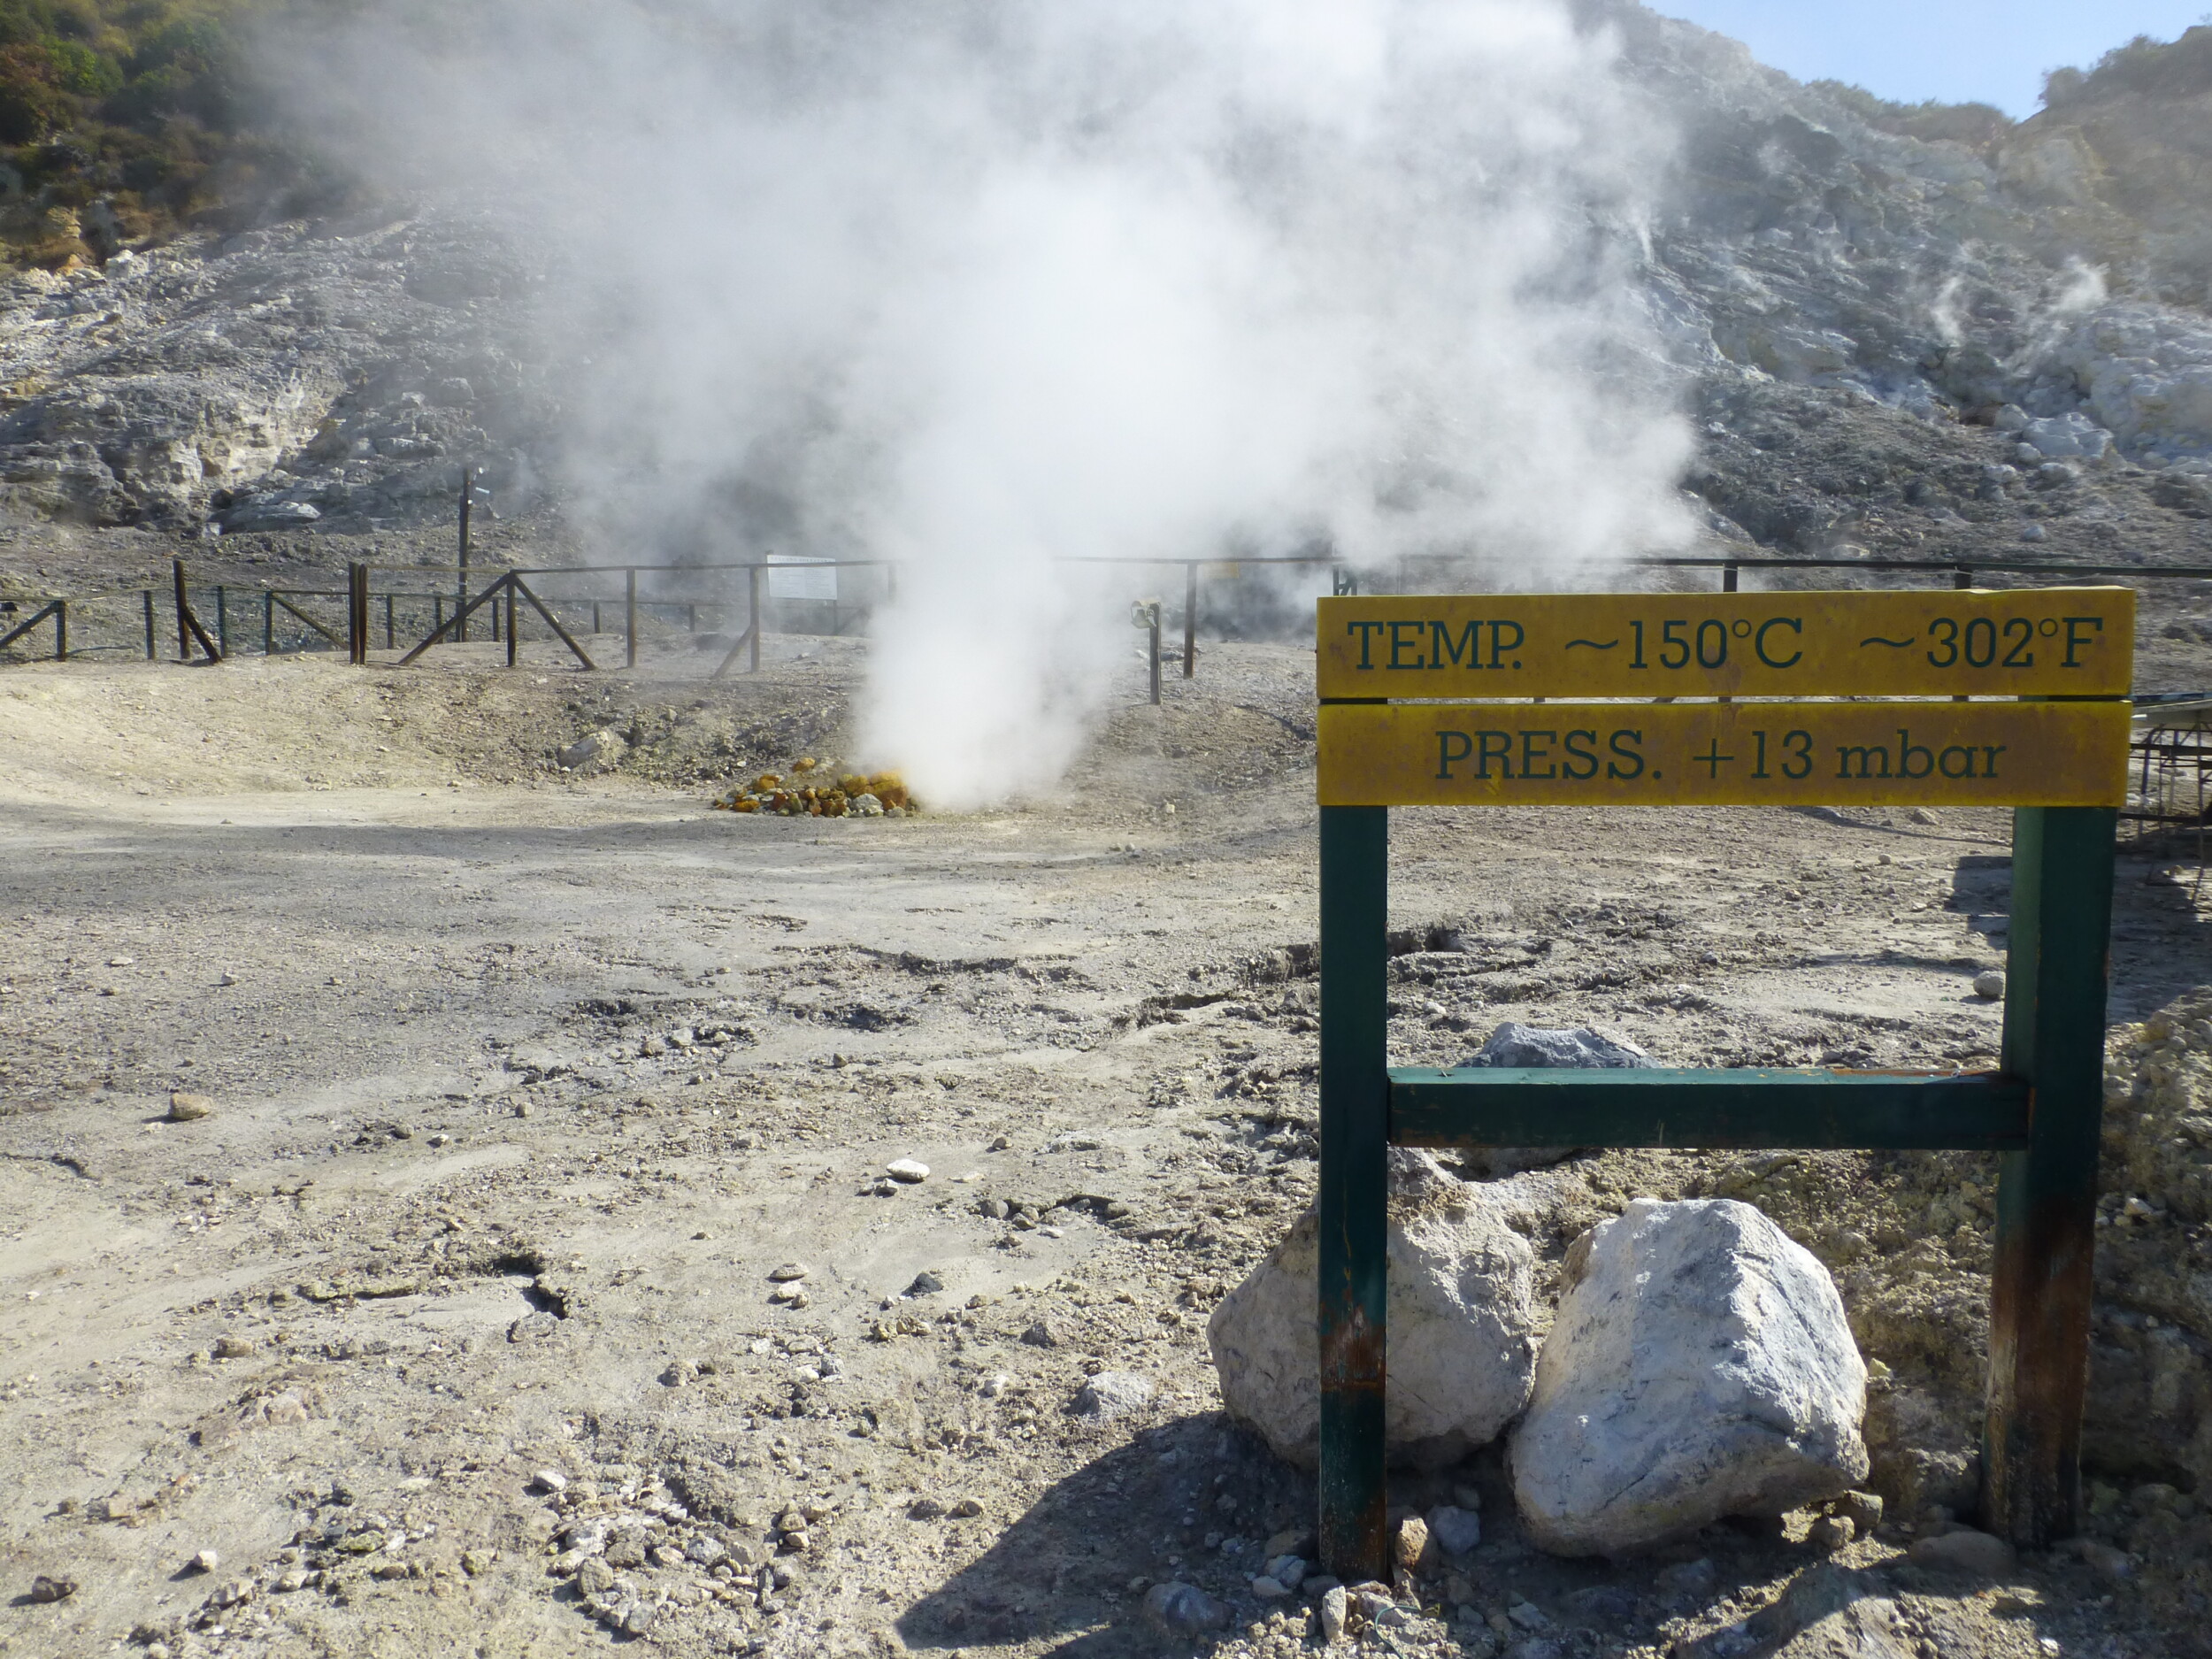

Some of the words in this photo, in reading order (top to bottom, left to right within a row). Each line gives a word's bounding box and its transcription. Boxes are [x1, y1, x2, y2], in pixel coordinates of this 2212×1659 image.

[1348, 620, 1525, 670] TEMP.
[1435, 730, 1661, 780] PRESS.
[1693, 730, 1814, 780] +13
[1835, 729, 2007, 779] mbar
